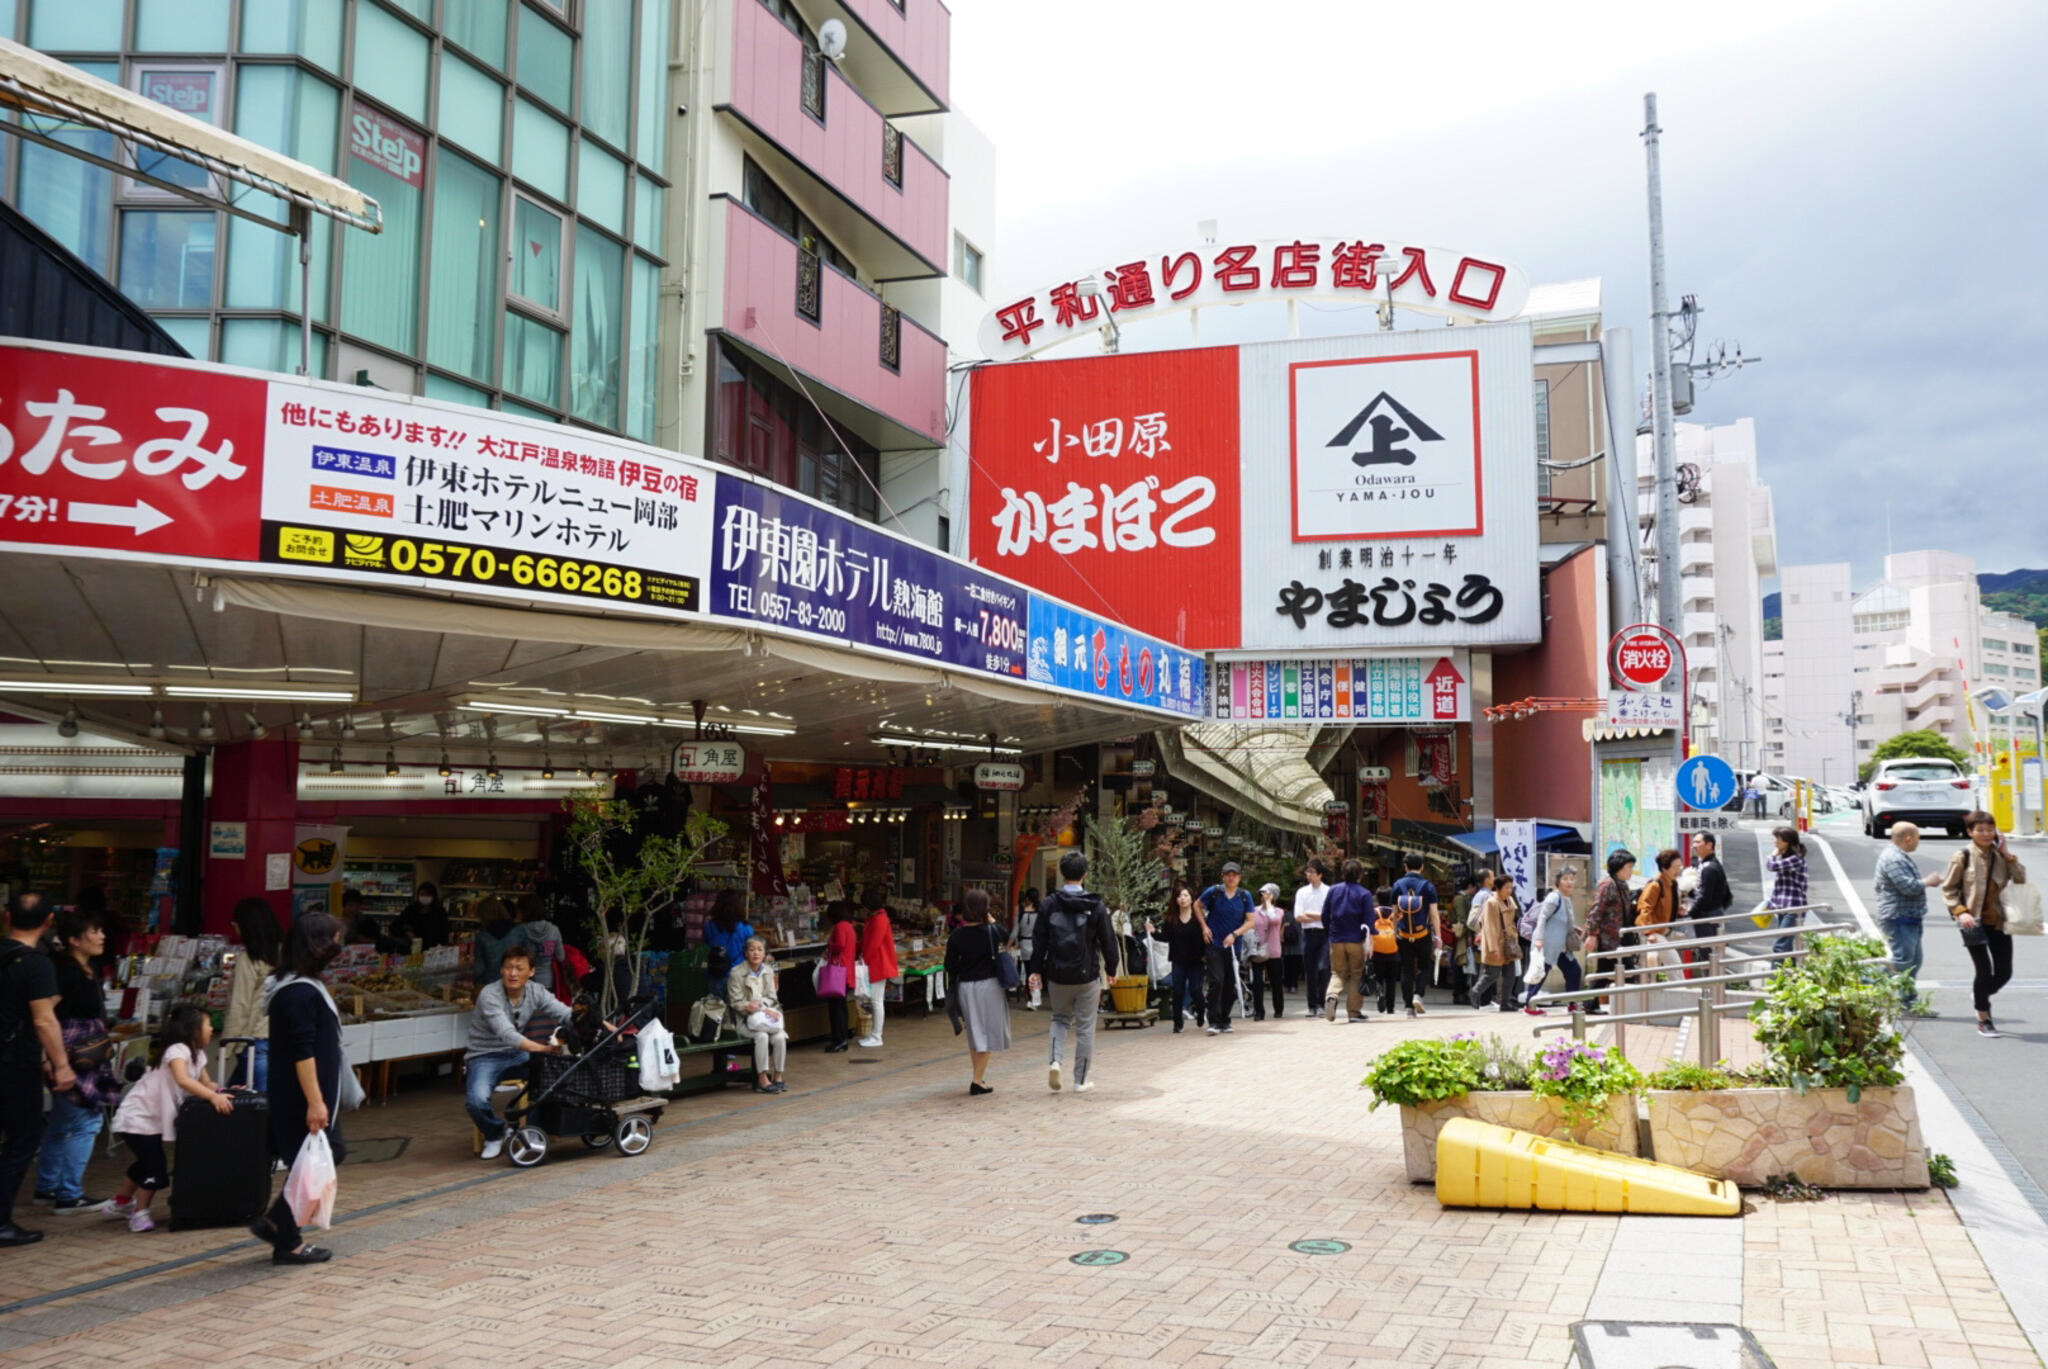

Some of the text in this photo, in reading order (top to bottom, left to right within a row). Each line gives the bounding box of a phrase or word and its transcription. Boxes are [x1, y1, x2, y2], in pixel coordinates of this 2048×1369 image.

[152, 84, 206, 110] Step
[352, 113, 421, 179] Step
[996, 241, 1506, 345] 平和通り名店街入口
[0, 388, 247, 490] たみ
[1033, 412, 1172, 465] 小田原
[314, 449, 393, 477] 伊東温泉
[1355, 474, 1416, 487] Odawara
[313, 489, 393, 515] 土肥温泉
[404, 455, 679, 531] 伊東ホテルニュー岡部
[1337, 488, 1435, 502] YAMA-JOU
[403, 494, 630, 553] 土肥マリンホテル
[992, 475, 1217, 556] かまぼこ
[285, 544, 327, 557] お問合せ
[291, 533, 323, 546] ご予約
[1318, 543, 1457, 570] 創業明治十一年
[390, 540, 642, 600] 0570-666268
[721, 504, 943, 628] 伊東園ホテル 熱海館
[728, 583, 845, 632] TEL 0557-83-2000
[1276, 574, 1503, 630] やまじょう
[876, 621, 943, 654] http://www.7800.jp
[1623, 650, 1667, 669] 消火栓
[1436, 675, 1455, 714] 近道
[702, 748, 738, 767] 角屋
[470, 773, 505, 793] 角屋
